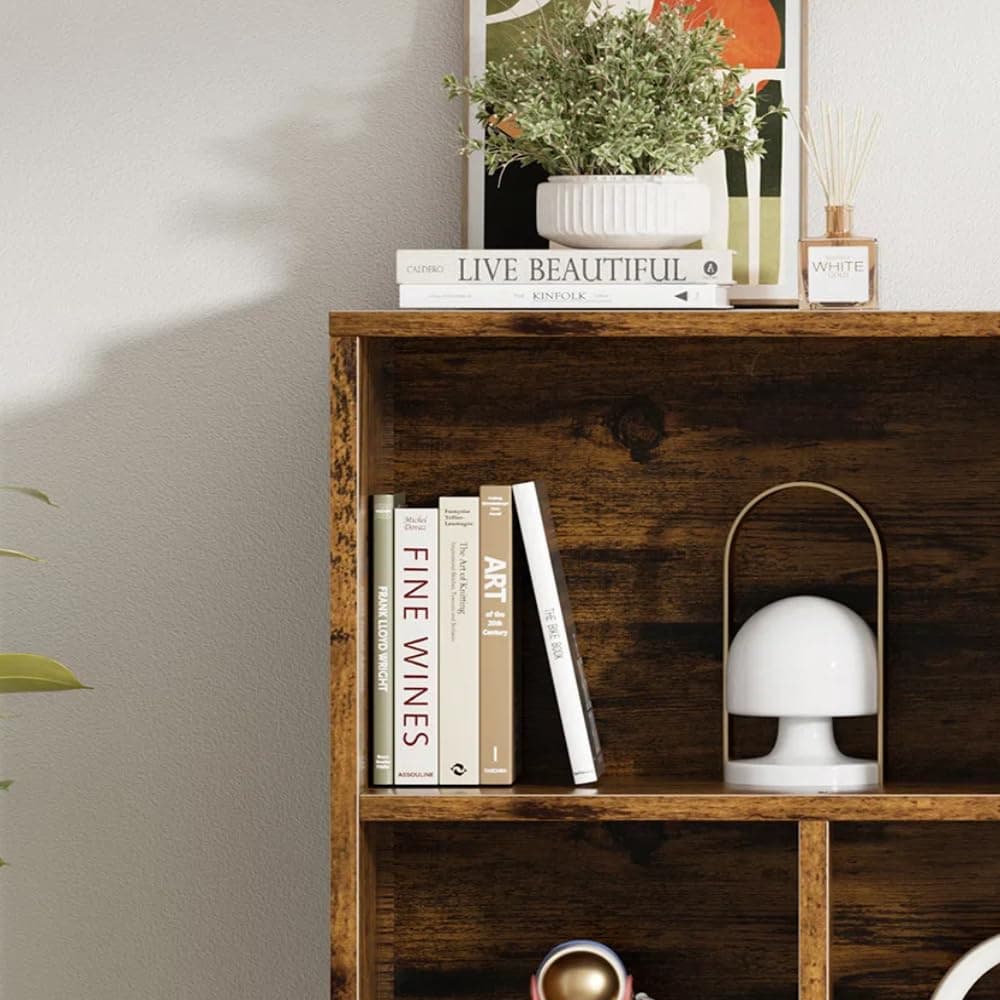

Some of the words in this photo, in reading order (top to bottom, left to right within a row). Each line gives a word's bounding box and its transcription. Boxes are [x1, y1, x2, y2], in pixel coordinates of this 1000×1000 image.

[458, 258, 517, 282] LIVE
[529, 258, 688, 282] BEAUTIFUL
[812, 261, 864, 272] WHITE
[532, 291, 587, 301] KINFOLK
[458, 543, 468, 555] The
[458, 558, 468, 571] Art
[459, 573, 468, 581] of
[483, 556, 507, 603] ART
[403, 547, 429, 620] FINE
[457, 582, 468, 615] Knitting
[377, 586, 389, 618] FRANK
[377, 620, 389, 650] LLOYD
[377, 651, 389, 693] WRIGHT
[403, 636, 429, 747] WINES
